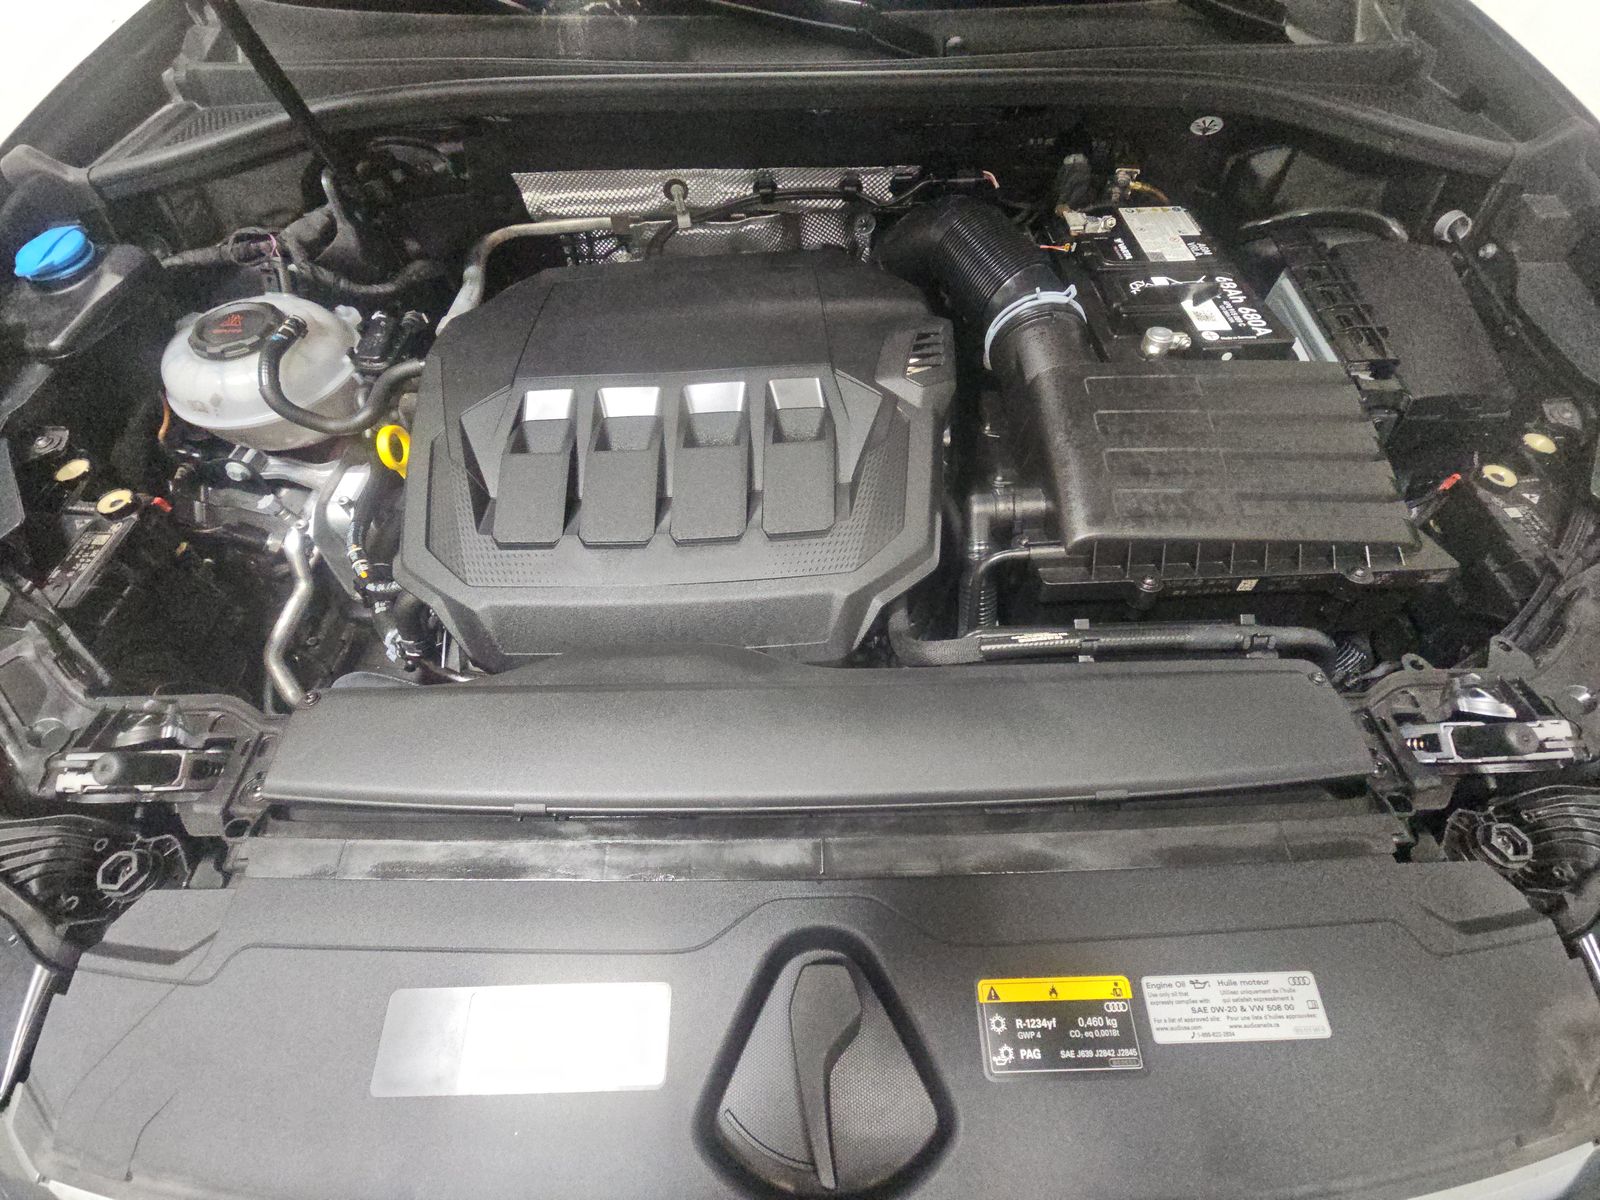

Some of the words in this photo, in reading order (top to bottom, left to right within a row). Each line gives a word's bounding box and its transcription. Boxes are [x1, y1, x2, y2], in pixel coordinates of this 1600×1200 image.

[1215, 276, 1247, 304] 68Ah
[1238, 307, 1273, 337] 680A
[1146, 982, 1172, 990] Engine
[1016, 1018, 1056, 1030] R-1234yf
[1078, 1016, 1104, 1028] 0,460
[1106, 1016, 1118, 1028] kg
[1018, 1031, 1035, 1040] GWP
[1084, 1030, 1094, 1039] eq
[1020, 1048, 1042, 1059] PAG
[1060, 1050, 1076, 1058] SAE
[1077, 1050, 1094, 1058] J639
[1095, 1048, 1116, 1058] J2842
[1117, 1048, 1138, 1056] J2845
